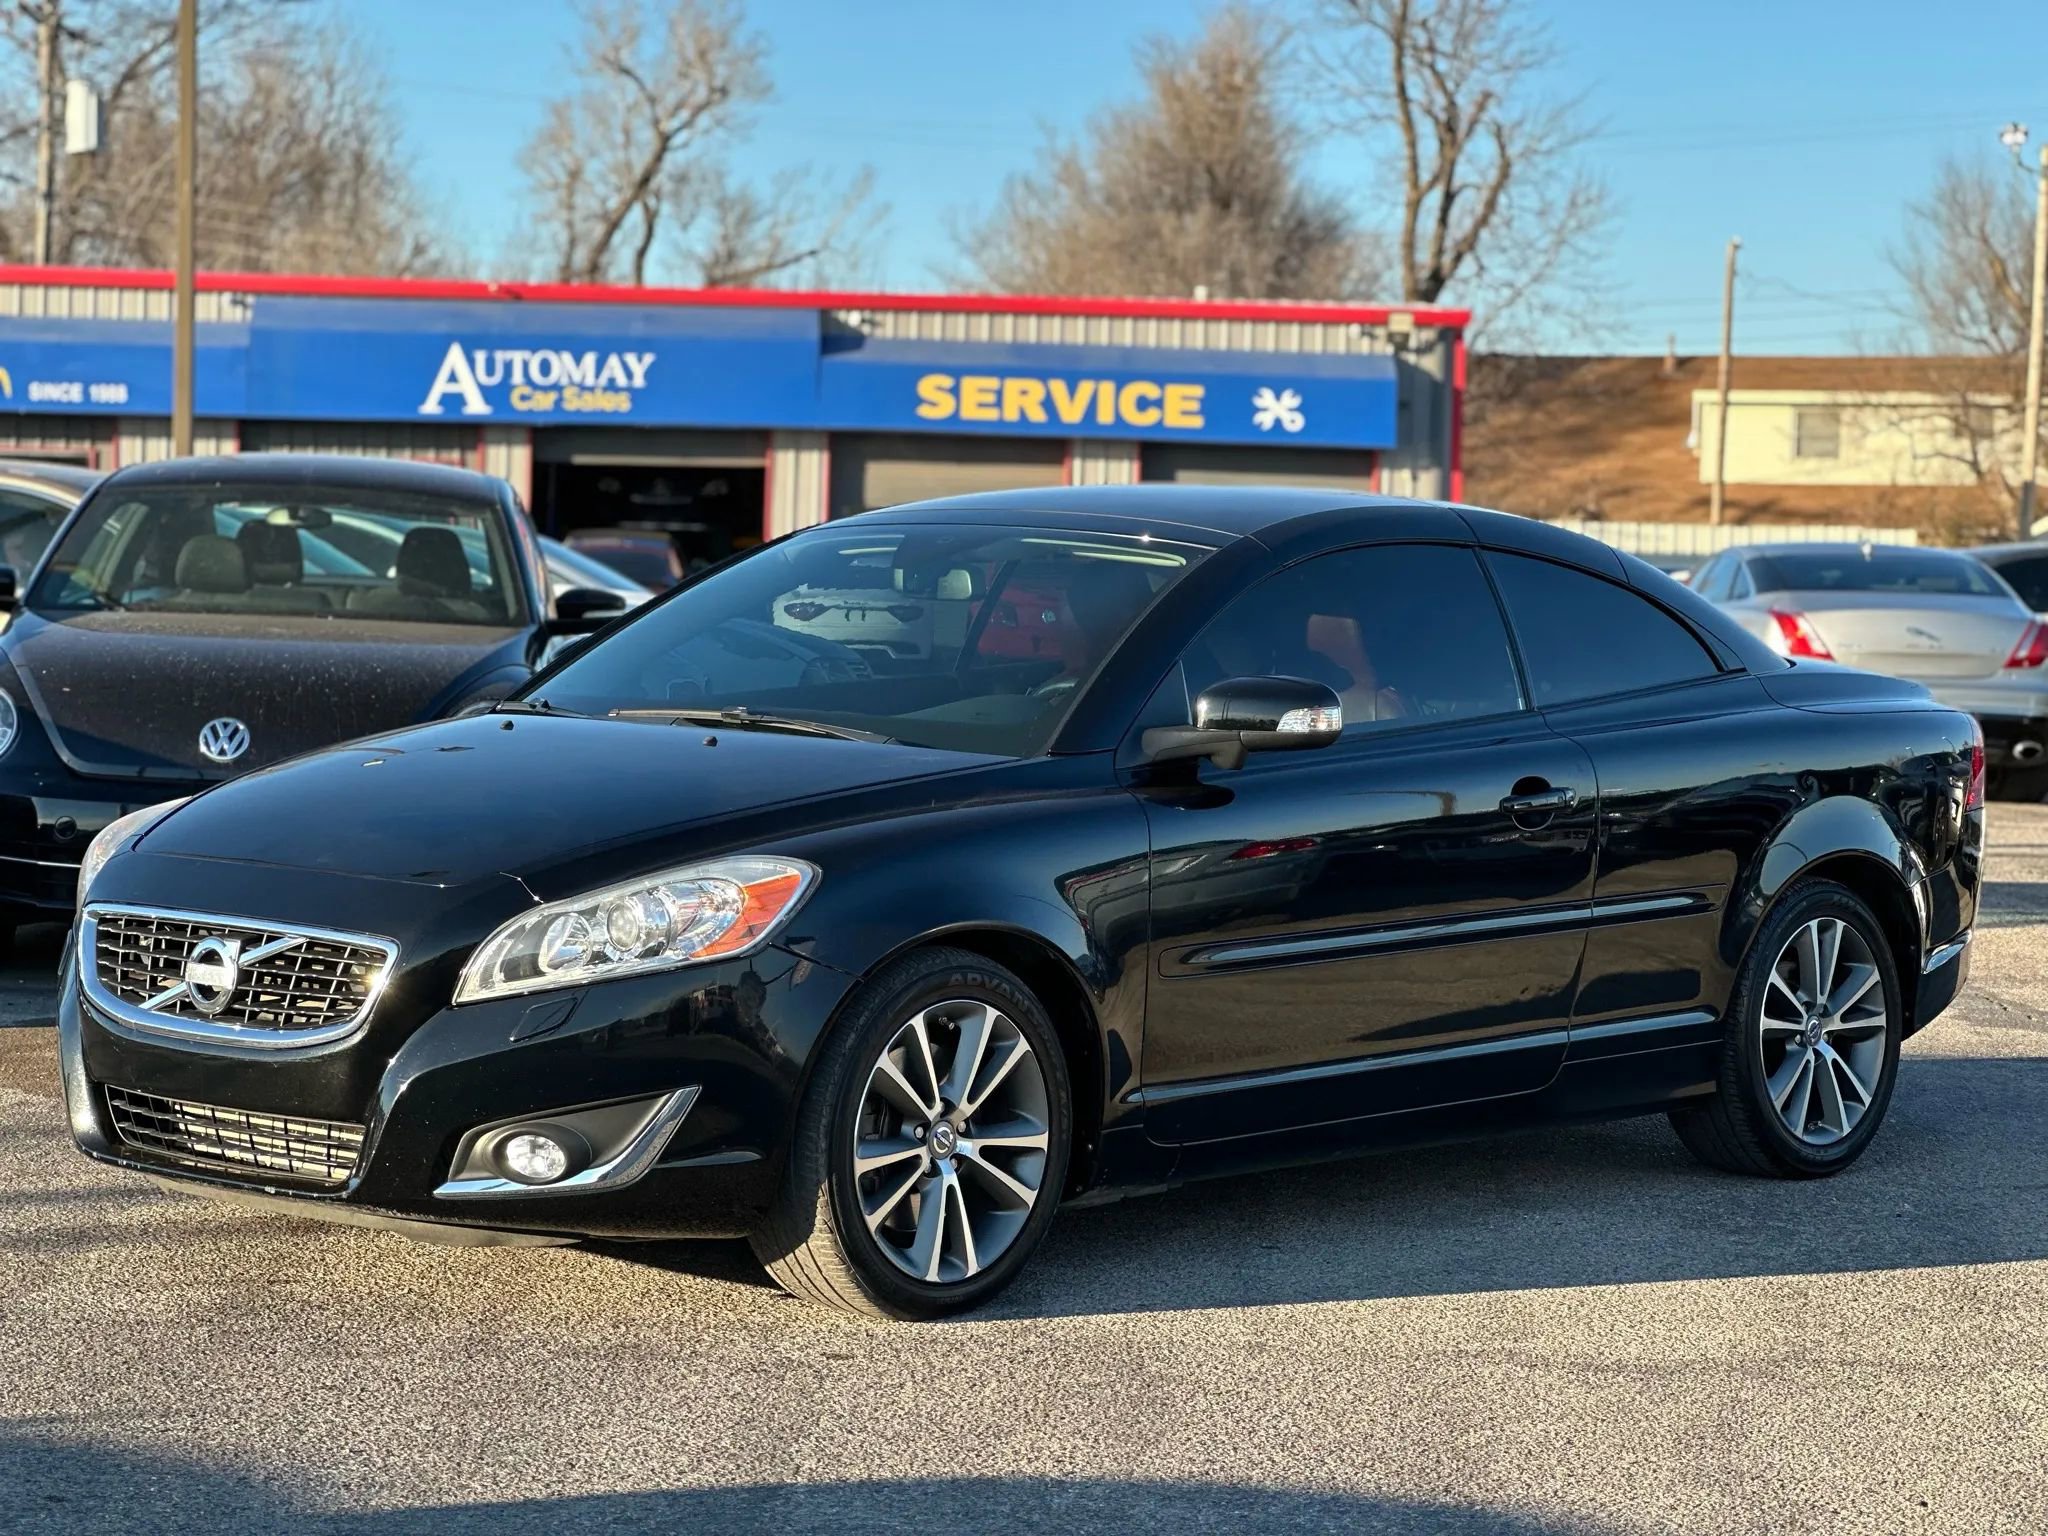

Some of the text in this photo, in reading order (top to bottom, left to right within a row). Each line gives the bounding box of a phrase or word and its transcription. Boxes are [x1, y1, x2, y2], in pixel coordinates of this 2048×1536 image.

[28, 381, 83, 403] SINCE
[417, 341, 656, 415] AUTOMAY
[510, 385, 632, 413] Car Sales
[915, 374, 1205, 429] SERVICE
[199, 717, 250, 762] VW
